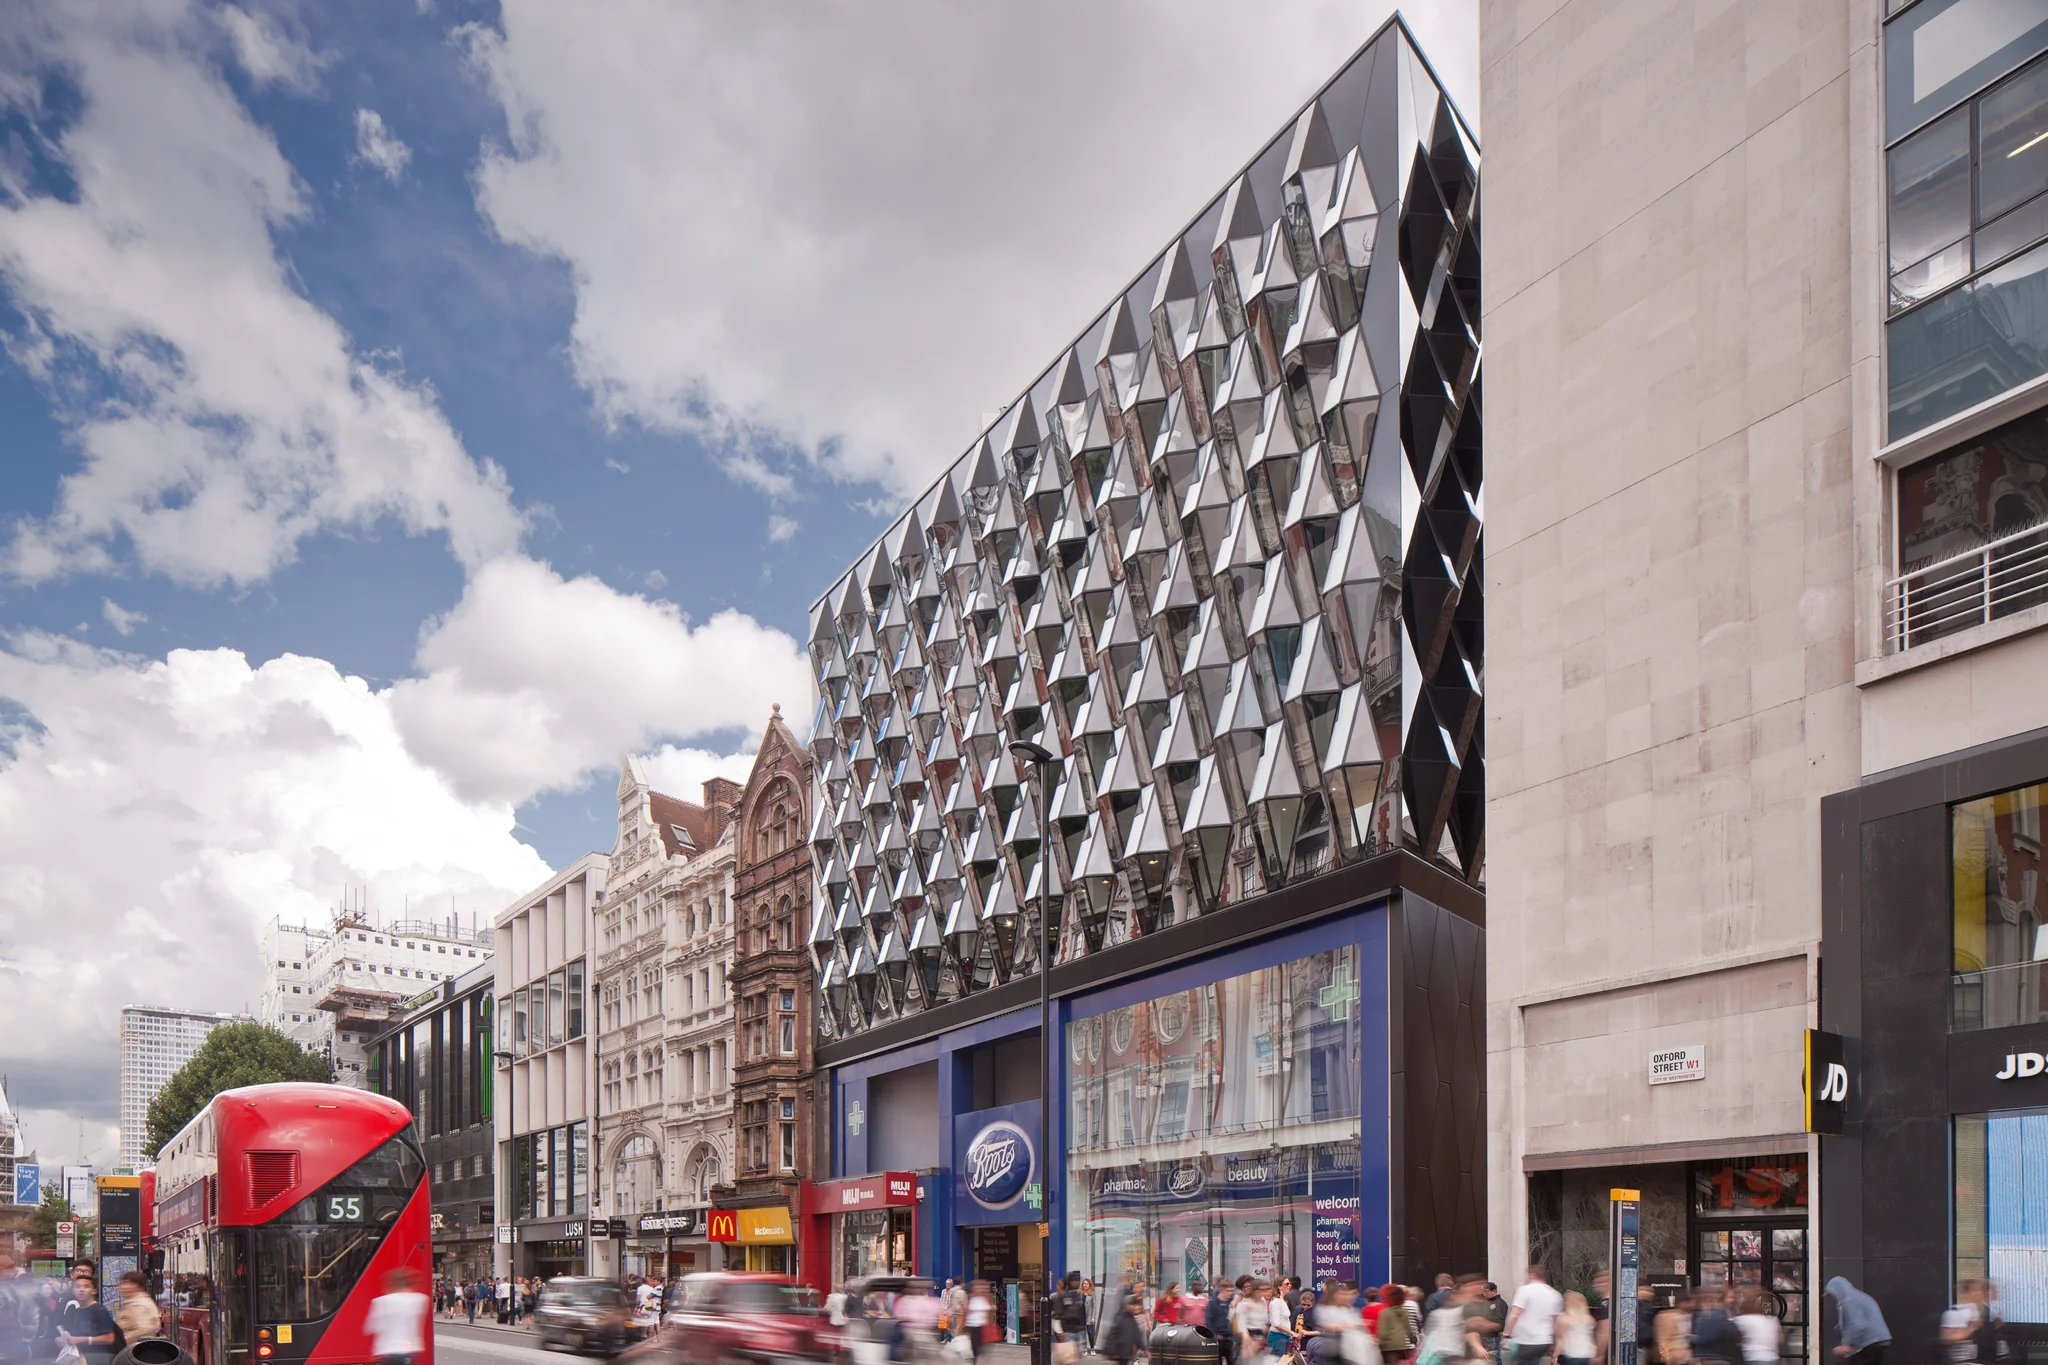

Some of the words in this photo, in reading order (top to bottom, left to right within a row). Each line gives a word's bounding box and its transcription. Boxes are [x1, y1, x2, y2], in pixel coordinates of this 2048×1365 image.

[1653, 1051, 1685, 1063] OXFORD
[1653, 1062, 1683, 1073] STREET
[1686, 1060, 1699, 1069] W1
[1820, 1063, 1848, 1102] JD
[970, 1139, 1015, 1189] Boots
[1171, 1169, 1197, 1189] Boots
[1228, 1165, 1269, 1182] beauty
[891, 1181, 910, 1191] MUJI
[842, 1188, 860, 1205] MUJI
[329, 1198, 360, 1219] 55
[1316, 1216, 1352, 1227] pharmacy
[565, 1223, 583, 1236] LUSH
[754, 1227, 784, 1235] McDonald's
[1316, 1230, 1341, 1239] beauty
[1316, 1242, 1333, 1251] food
[1334, 1242, 1340, 1250] &
[1341, 1241, 1360, 1250] drink
[1316, 1255, 1334, 1265] baby
[1335, 1255, 1341, 1263] &
[1342, 1254, 1360, 1263] child
[1316, 1268, 1338, 1278] photo
